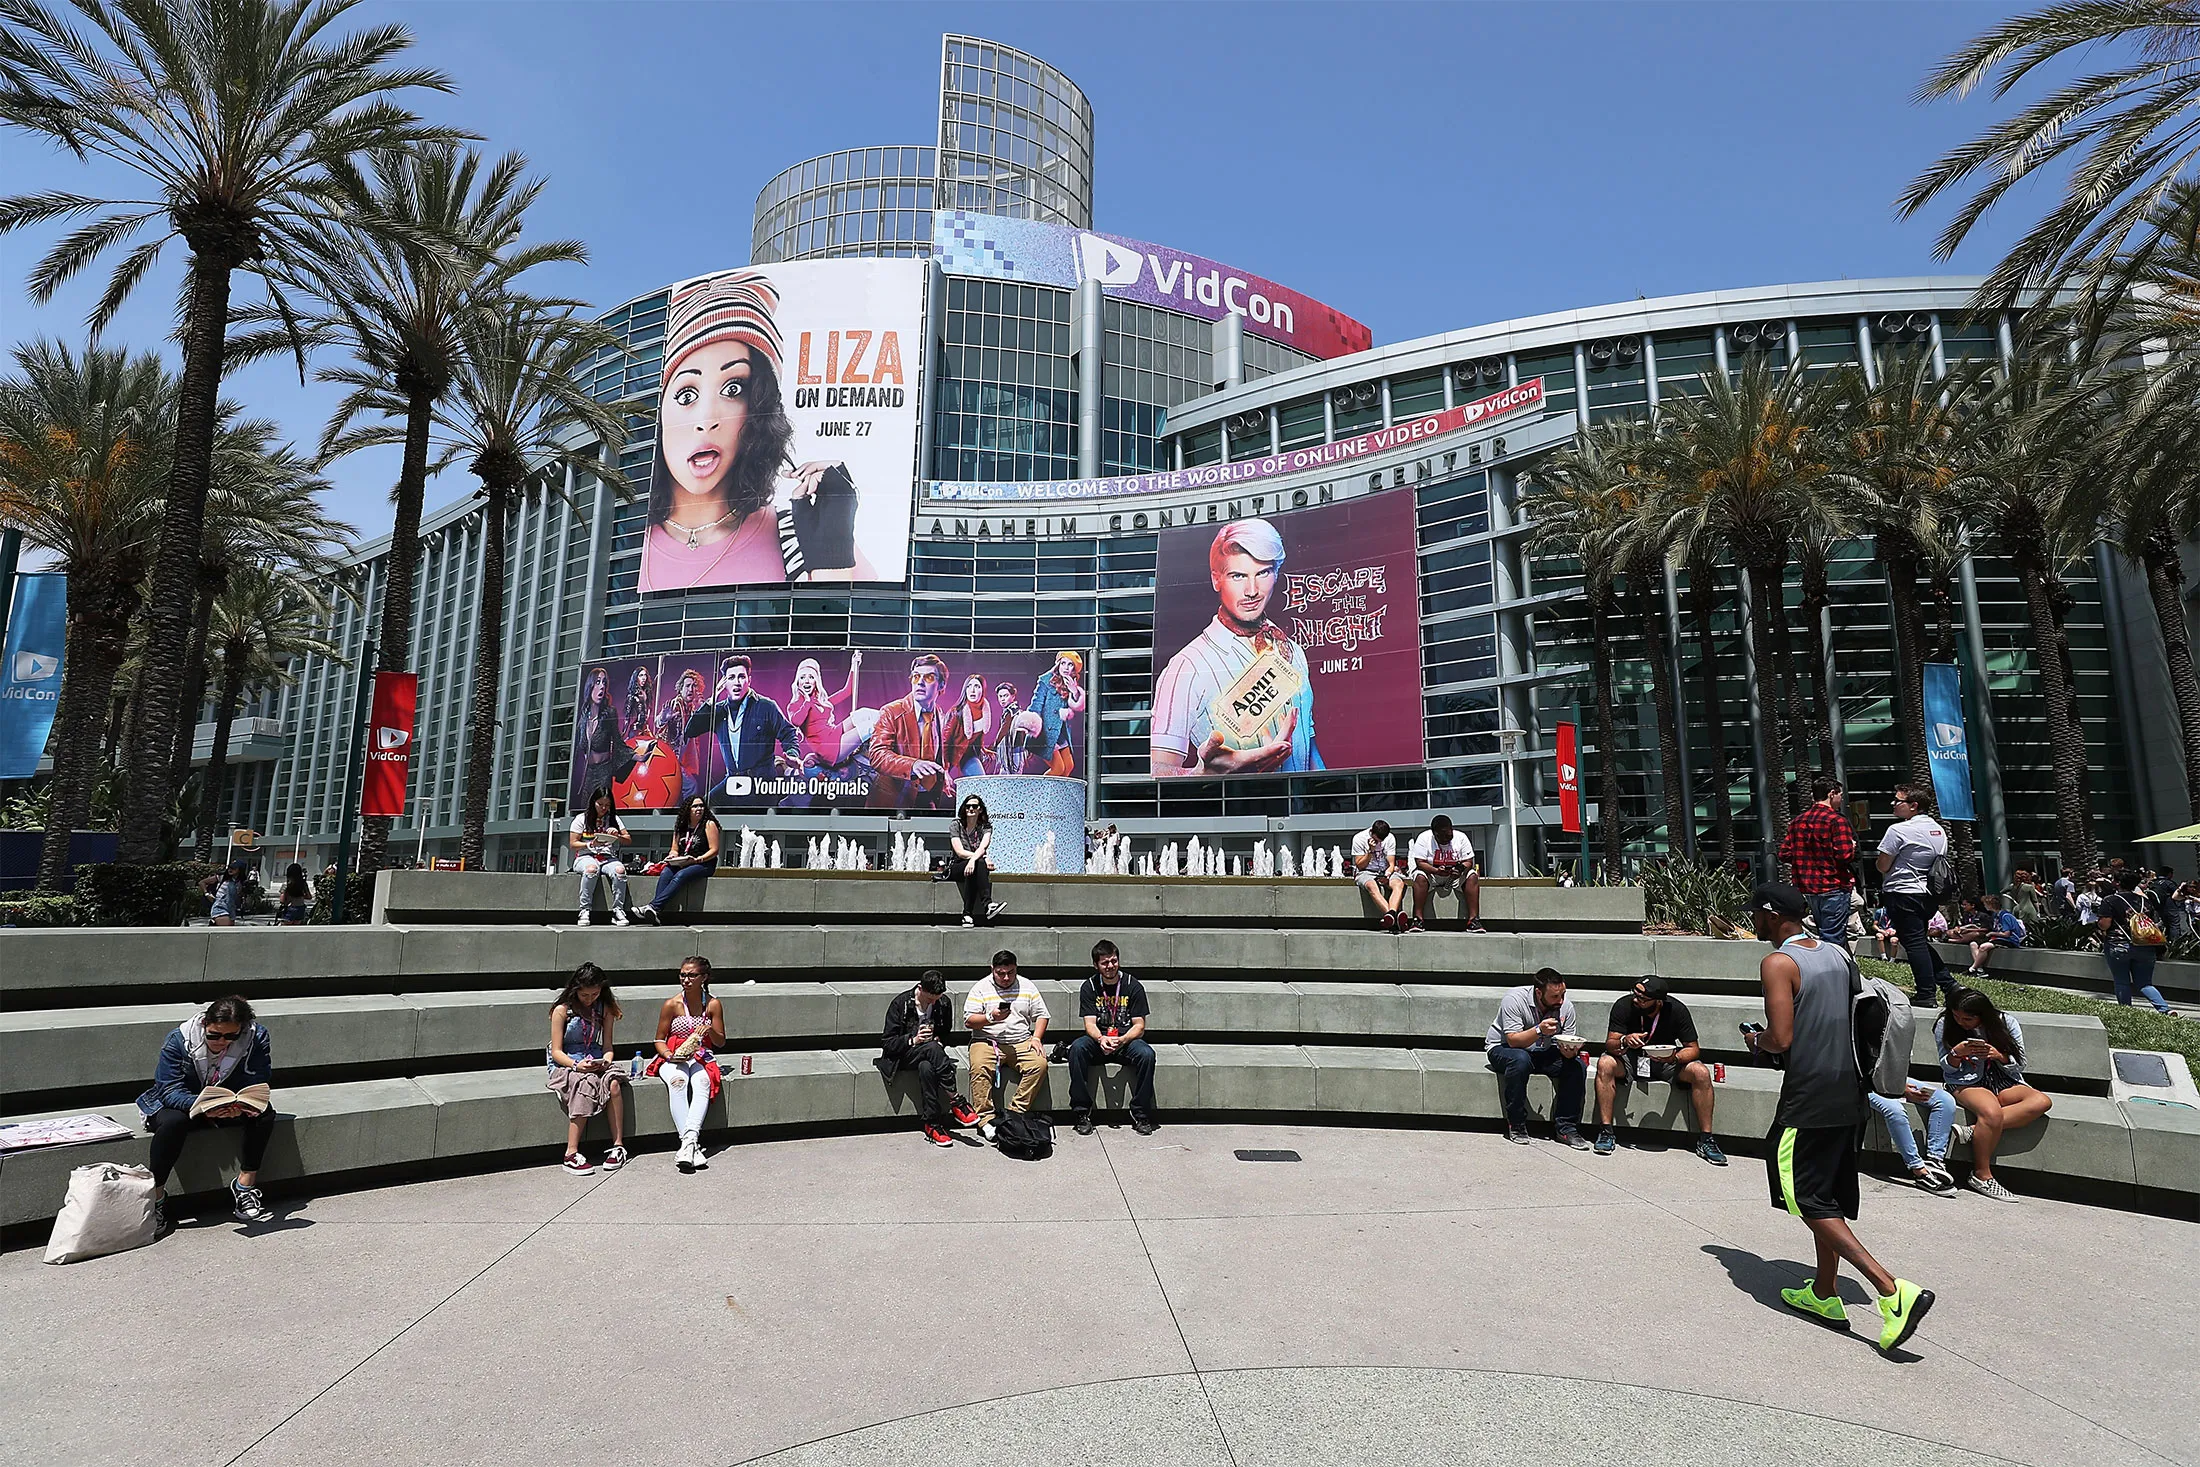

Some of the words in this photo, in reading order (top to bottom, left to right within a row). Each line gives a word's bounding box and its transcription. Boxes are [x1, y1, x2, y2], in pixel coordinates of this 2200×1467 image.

[1148, 253, 1295, 335] VidCon
[798, 331, 904, 385] LIZA
[796, 388, 820, 408] ON
[826, 387, 904, 408] DEMAND
[816, 421, 851, 437] JUNE
[856, 421, 873, 437] 27
[960, 485, 1003, 497] VidCon
[1017, 482, 1109, 498] WELCOME
[1114, 477, 1139, 495] TO
[1146, 470, 1182, 489] THE
[1188, 459, 1256, 485] WORLD
[1262, 456, 1288, 474] OF
[1294, 438, 1369, 467] ONLINE
[1374, 417, 1439, 449] VIDEO
[1485, 385, 1539, 413] VidCon
[931, 516, 1077, 535] ANAHEIM
[1109, 483, 1333, 530] CONVENTION
[1369, 437, 1508, 490] CENTER
[1282, 565, 1387, 613] ESCAPE
[1332, 593, 1367, 614] THE
[1290, 604, 1387, 652] NIGHT
[1320, 658, 1348, 674] JUNE
[1351, 656, 1363, 670] 21
[1, 687, 56, 700] VidCon
[1232, 668, 1277, 717] ADMIT
[1248, 685, 1279, 717] ONE
[370, 752, 407, 761] VidCon
[1931, 750, 1967, 761] VidCon
[753, 777, 806, 795] YouTube
[809, 777, 869, 800] Originals
[240, 833, 250, 844] C
